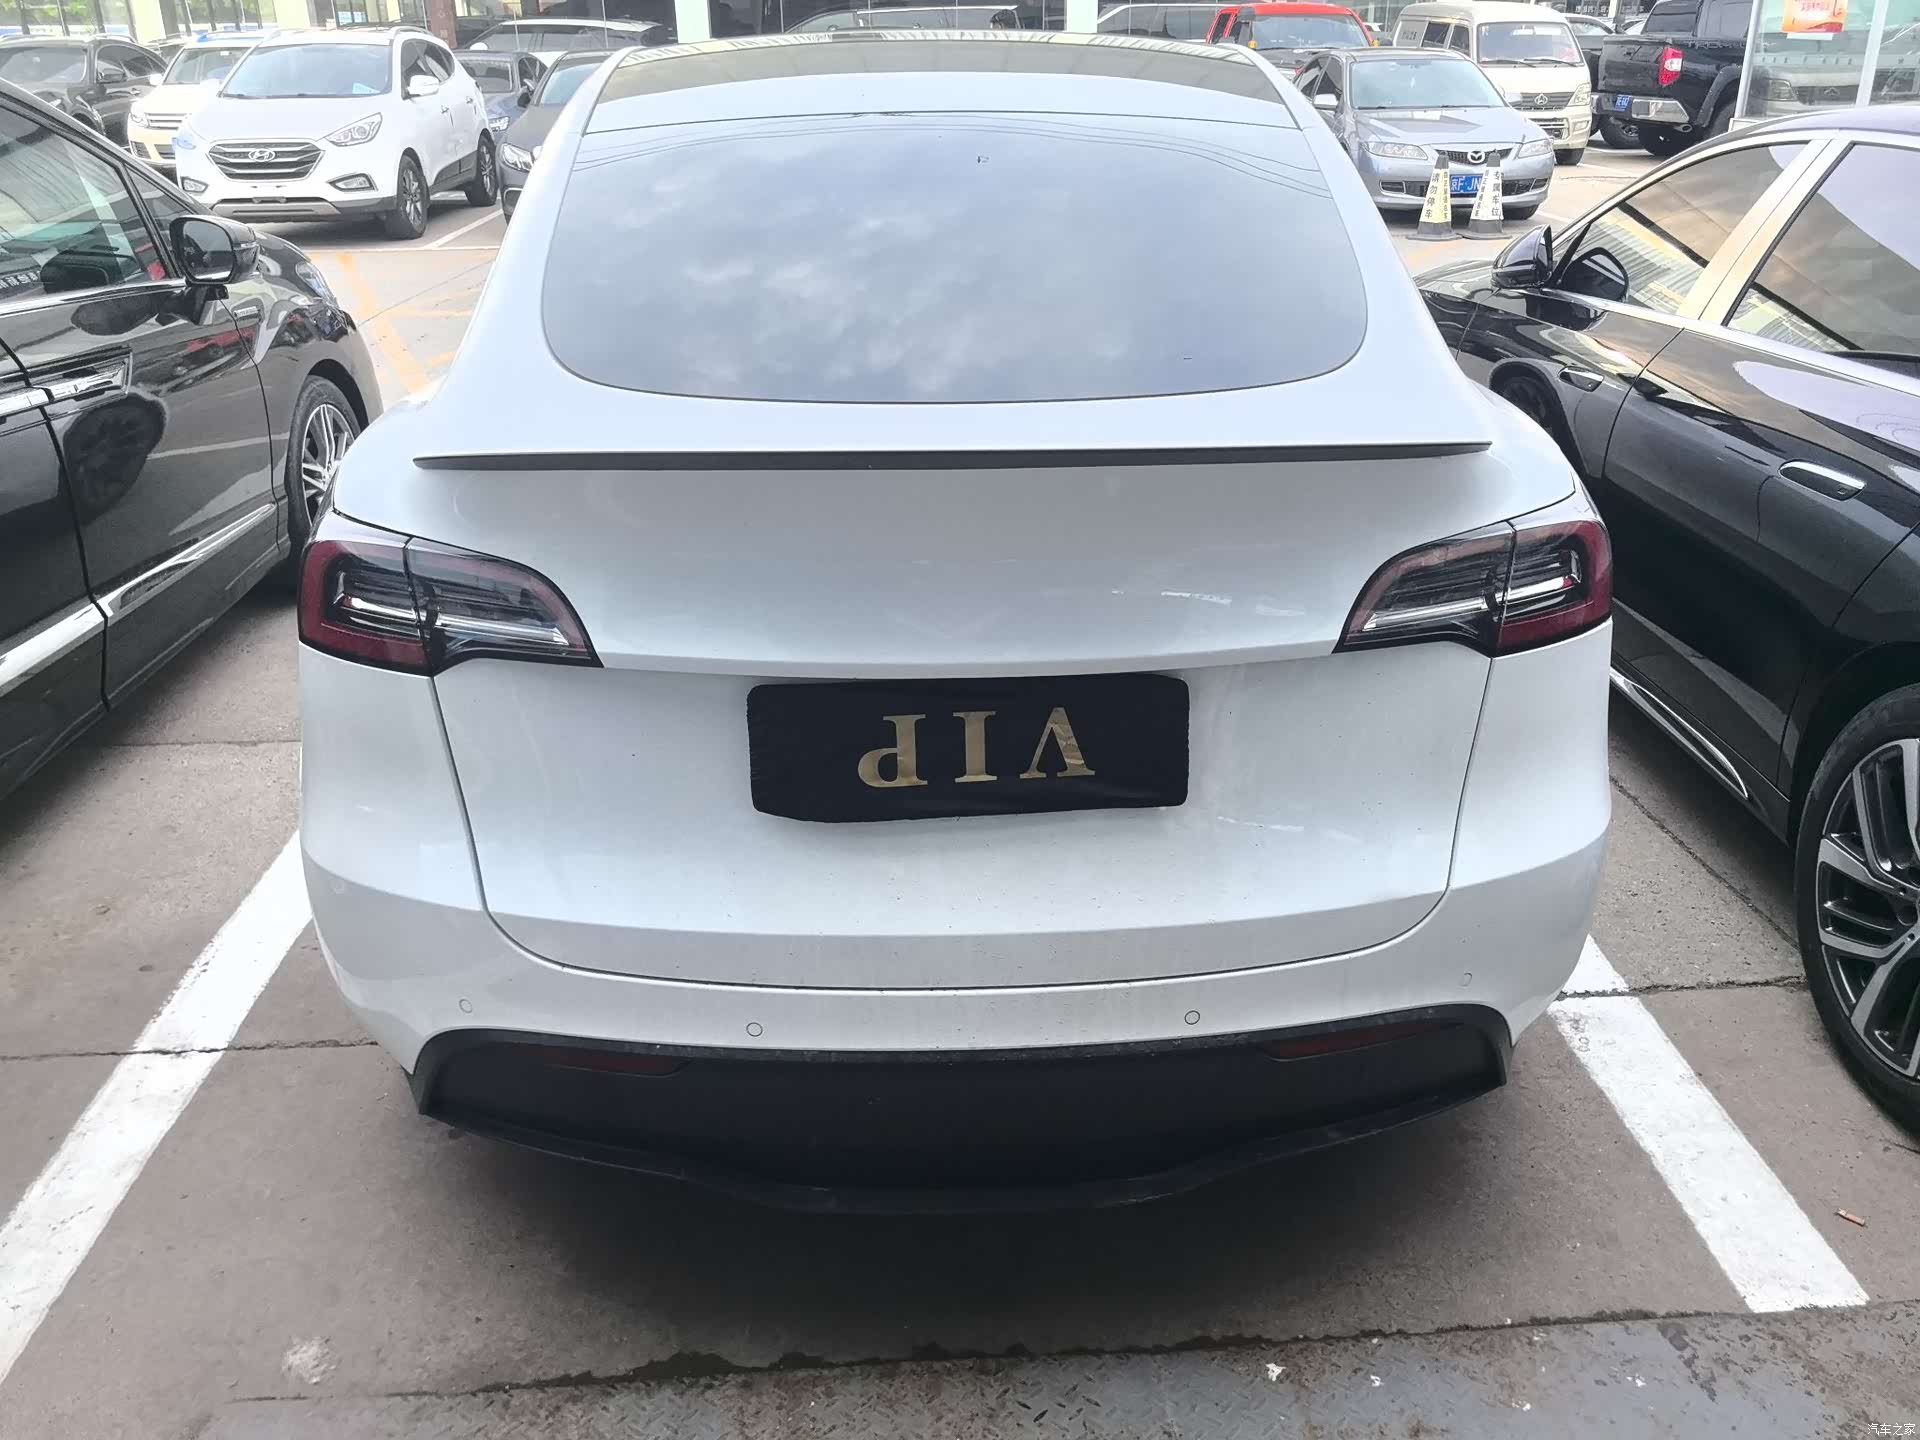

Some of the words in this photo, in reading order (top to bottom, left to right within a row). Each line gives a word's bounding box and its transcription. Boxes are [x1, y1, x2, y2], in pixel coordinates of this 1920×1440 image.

[1424, 172, 1440, 219] 请勿停车
[1491, 171, 1501, 216] 专属车位
[857, 706, 1096, 788] VIP
